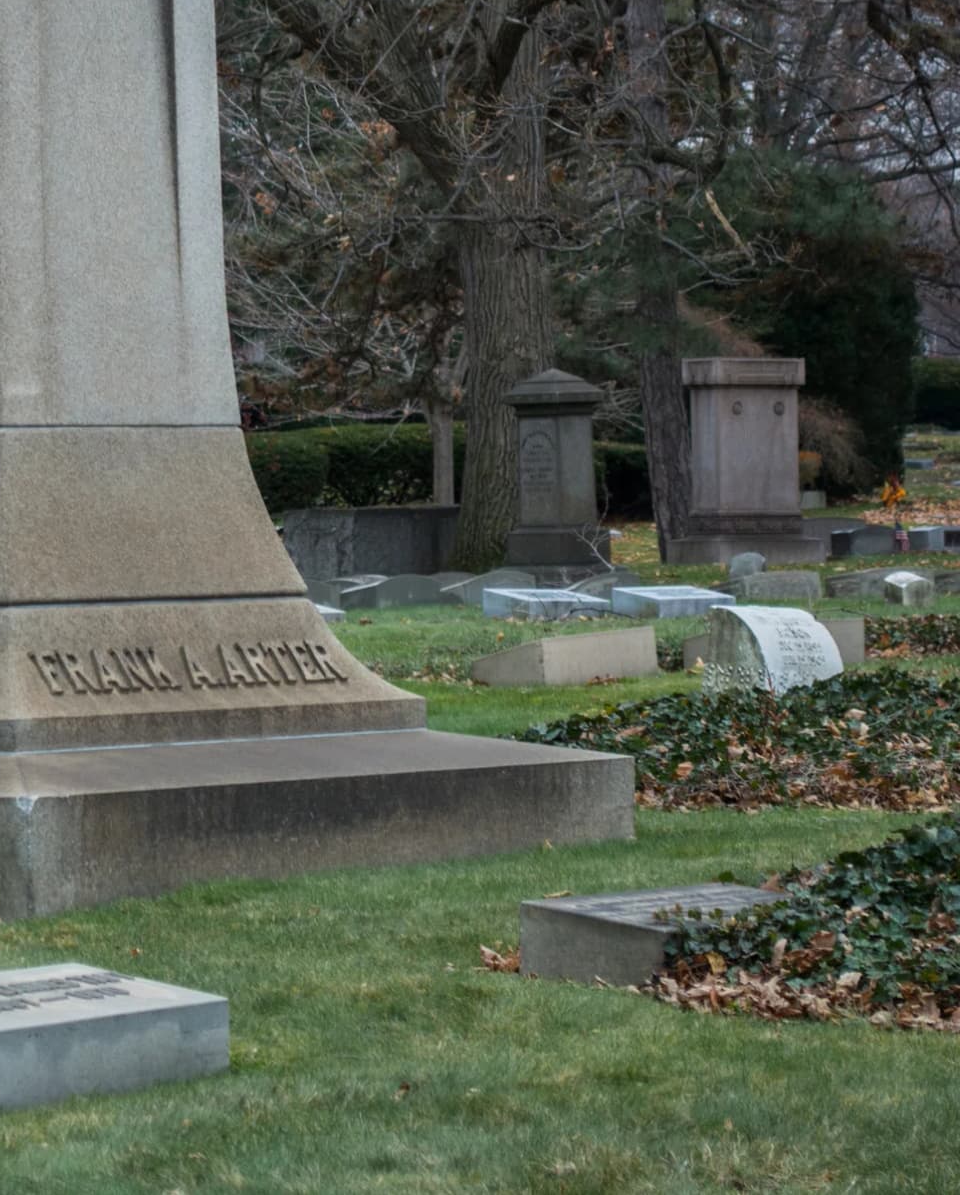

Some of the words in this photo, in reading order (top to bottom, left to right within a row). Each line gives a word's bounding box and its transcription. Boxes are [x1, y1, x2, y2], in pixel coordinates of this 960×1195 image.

[28, 647, 182, 696] FRANK
[181, 644, 227, 690] A.
[218, 639, 349, 688] ARTER
